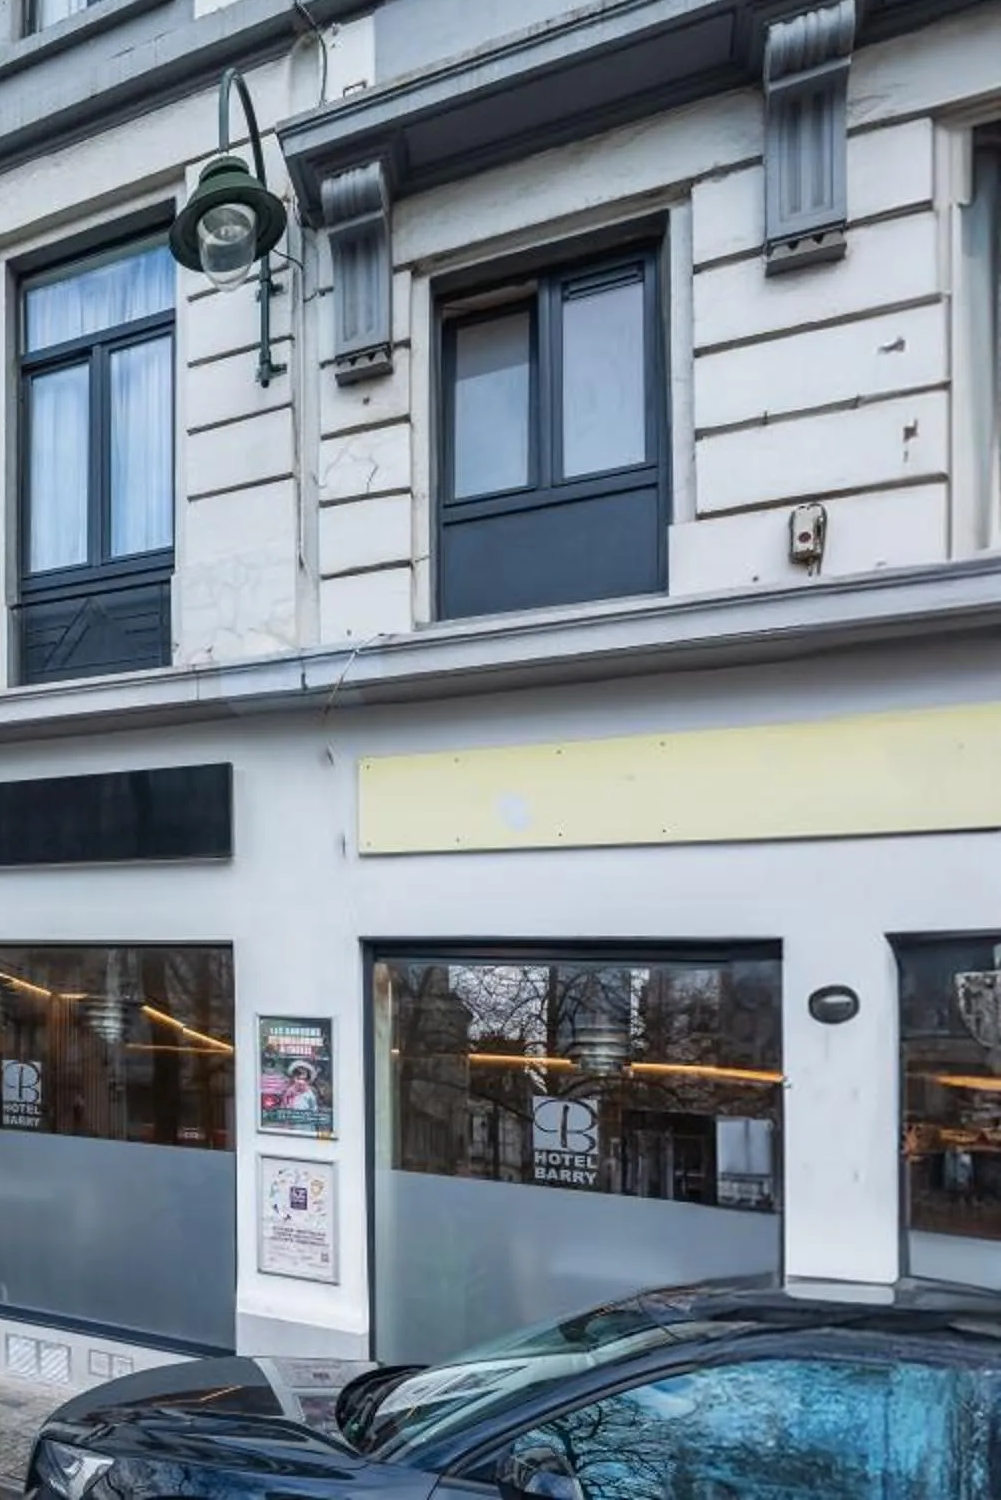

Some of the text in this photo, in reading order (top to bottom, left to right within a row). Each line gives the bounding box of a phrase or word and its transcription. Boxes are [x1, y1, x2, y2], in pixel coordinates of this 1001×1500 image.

[2, 1103, 41, 1115] HOTEL
[534, 1151, 597, 1169] HOTEL
[534, 1166, 597, 1185] BARRY
